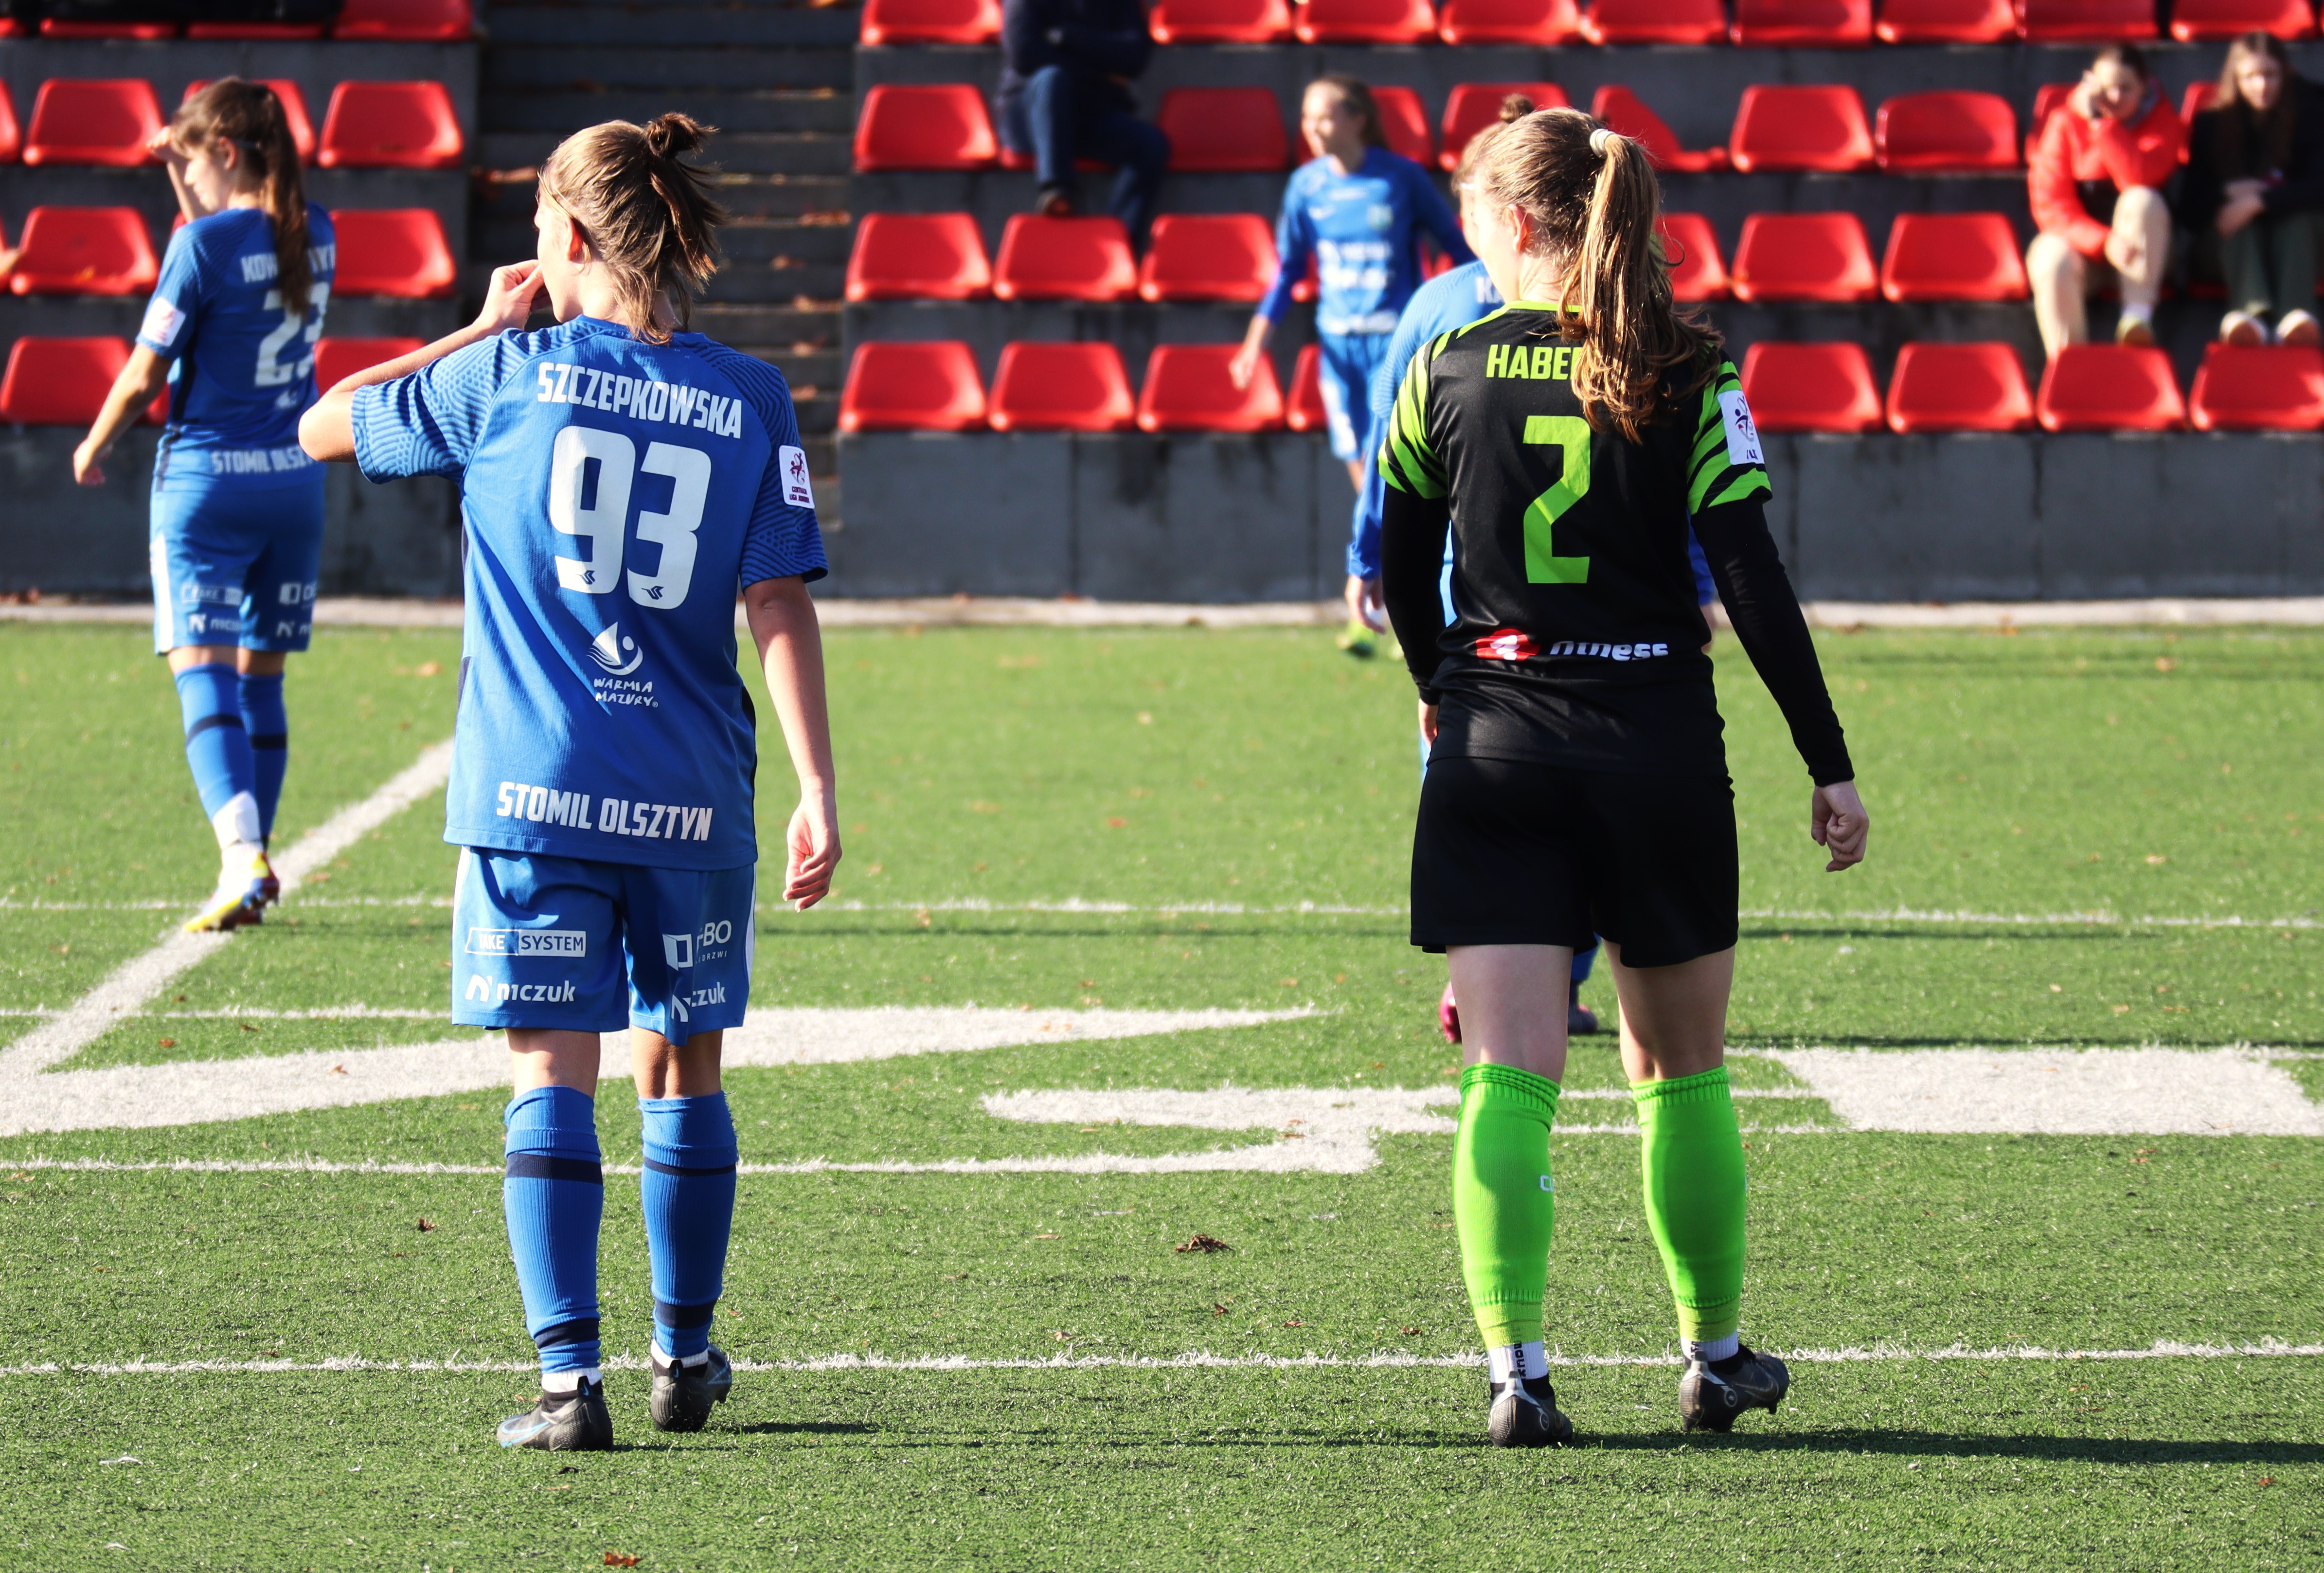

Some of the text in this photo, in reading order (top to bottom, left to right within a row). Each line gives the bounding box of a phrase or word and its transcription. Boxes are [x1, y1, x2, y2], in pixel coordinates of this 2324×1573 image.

[537, 362, 742, 439] SZCZEPKOWSKA
[550, 425, 711, 609] 93
[1523, 416, 1590, 584] 2
[594, 677, 652, 692] WARMIA
[497, 781, 713, 841] STOMIL OLSZTYN
[521, 935, 584, 951] SYSTEM
[497, 980, 576, 1002] niczuk
